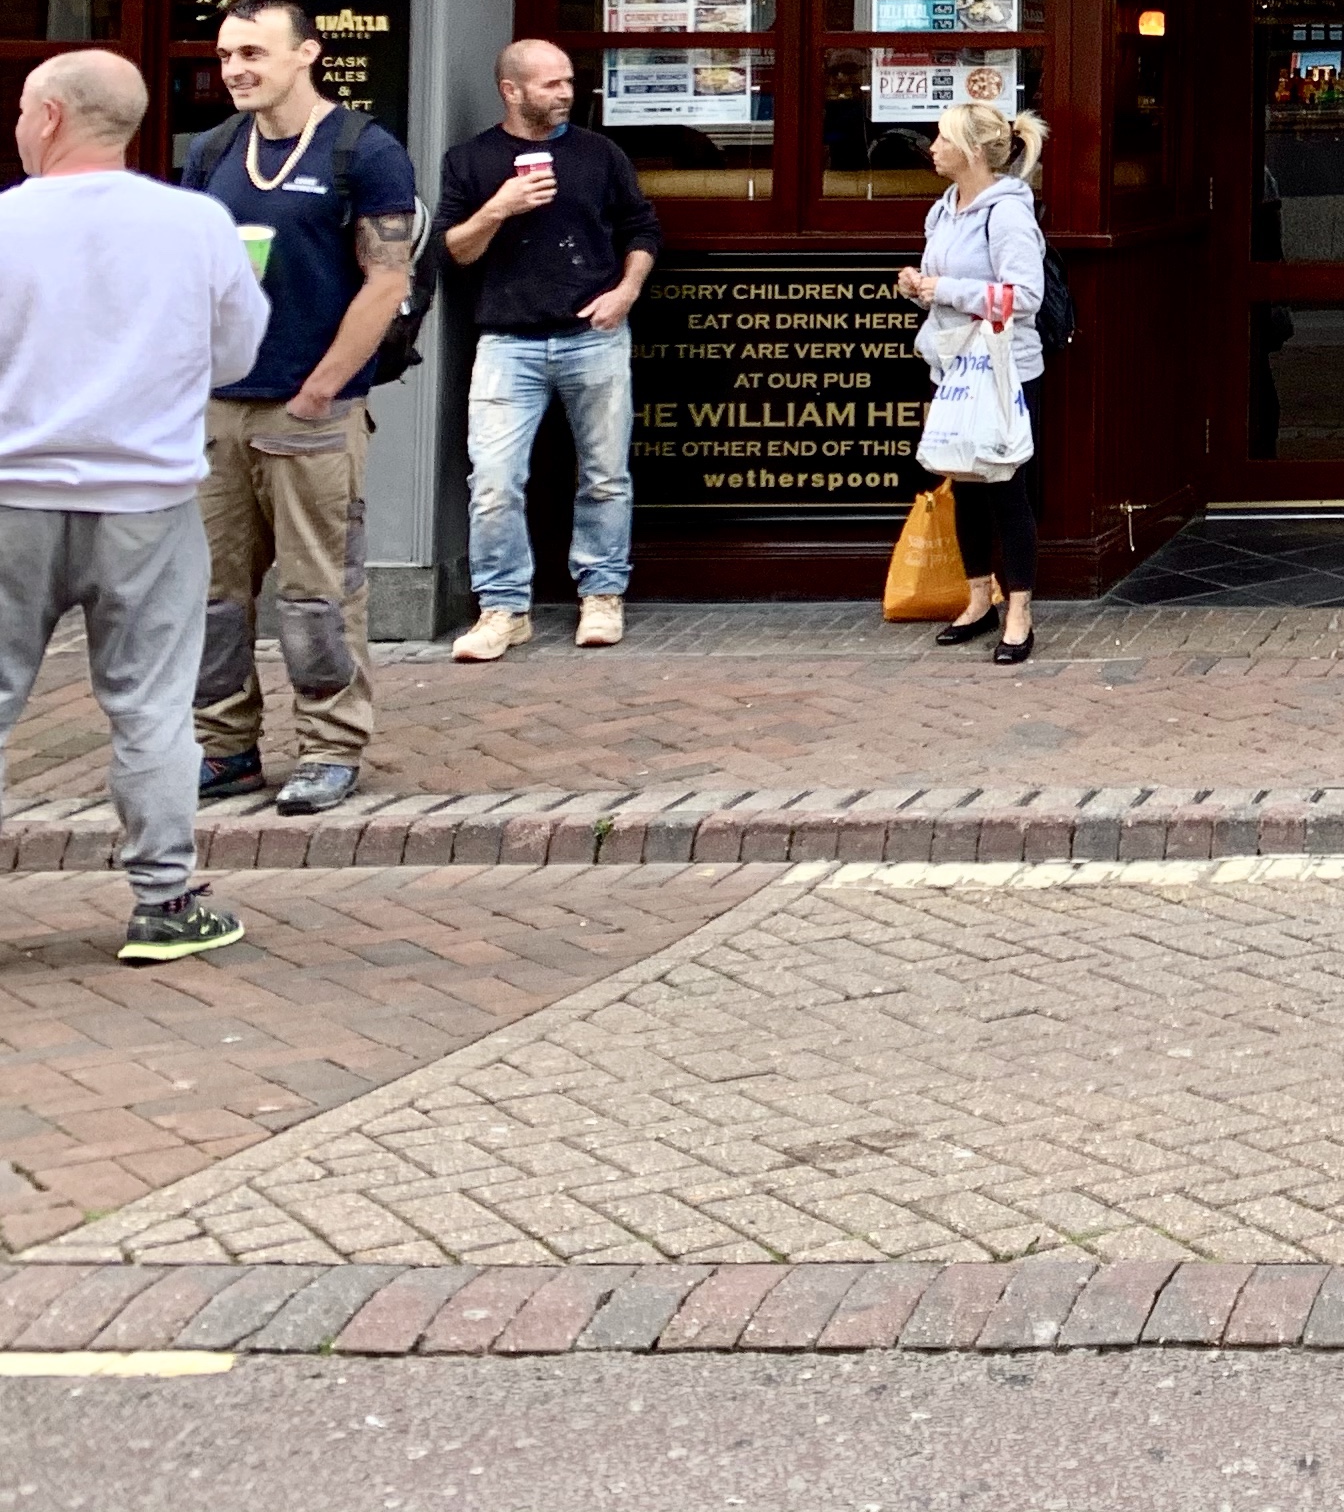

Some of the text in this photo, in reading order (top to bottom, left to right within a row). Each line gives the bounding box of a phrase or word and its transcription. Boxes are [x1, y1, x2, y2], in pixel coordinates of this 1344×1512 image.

[322, 56, 367, 67] CASK
[322, 71, 367, 82] ALES
[338, 85, 351, 96] &
[880, 77, 928, 94] PIZZA
[650, 284, 727, 300] SORRY
[732, 284, 854, 300] CHILDREN
[688, 313, 918, 329] EAT OR DRINK HERE
[630, 343, 669, 359] BUT
[675, 343, 736, 359] THEY
[740, 343, 788, 359] ARE
[794, 343, 855, 359] VERY
[734, 373, 871, 388] AT OUR PUB
[632, 403, 678, 427] HE
[687, 402, 856, 427] WILLIAM
[632, 440, 911, 456] THE OTHER END OF THIS
[703, 468, 899, 491] wetherspoon
